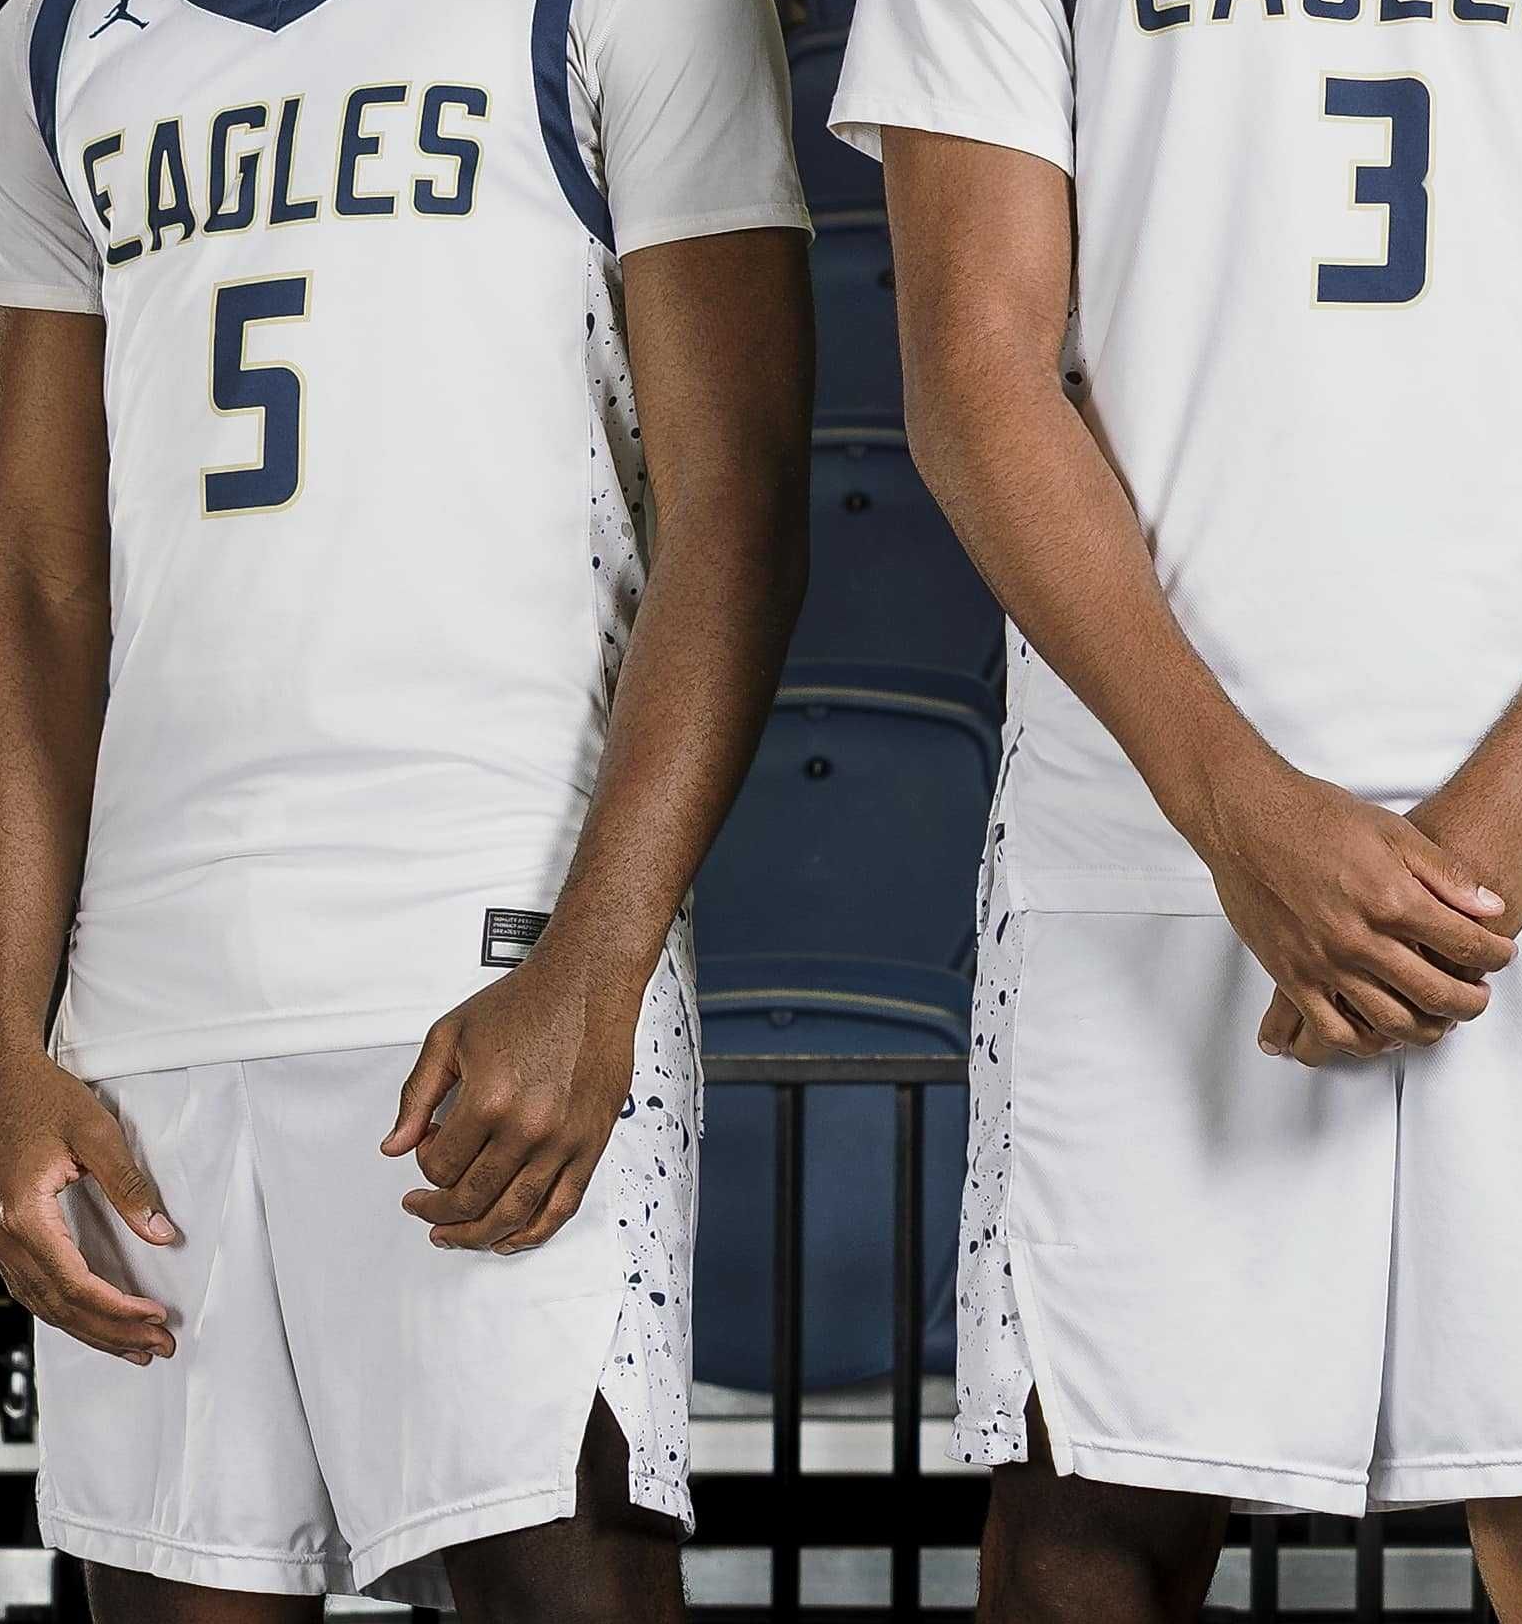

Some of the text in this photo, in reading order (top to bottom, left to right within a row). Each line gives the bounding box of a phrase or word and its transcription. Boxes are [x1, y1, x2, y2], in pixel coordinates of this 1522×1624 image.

[80, 81, 493, 269] EAGLES
[1310, 71, 1437, 309] 3
[200, 270, 313, 520] 5
